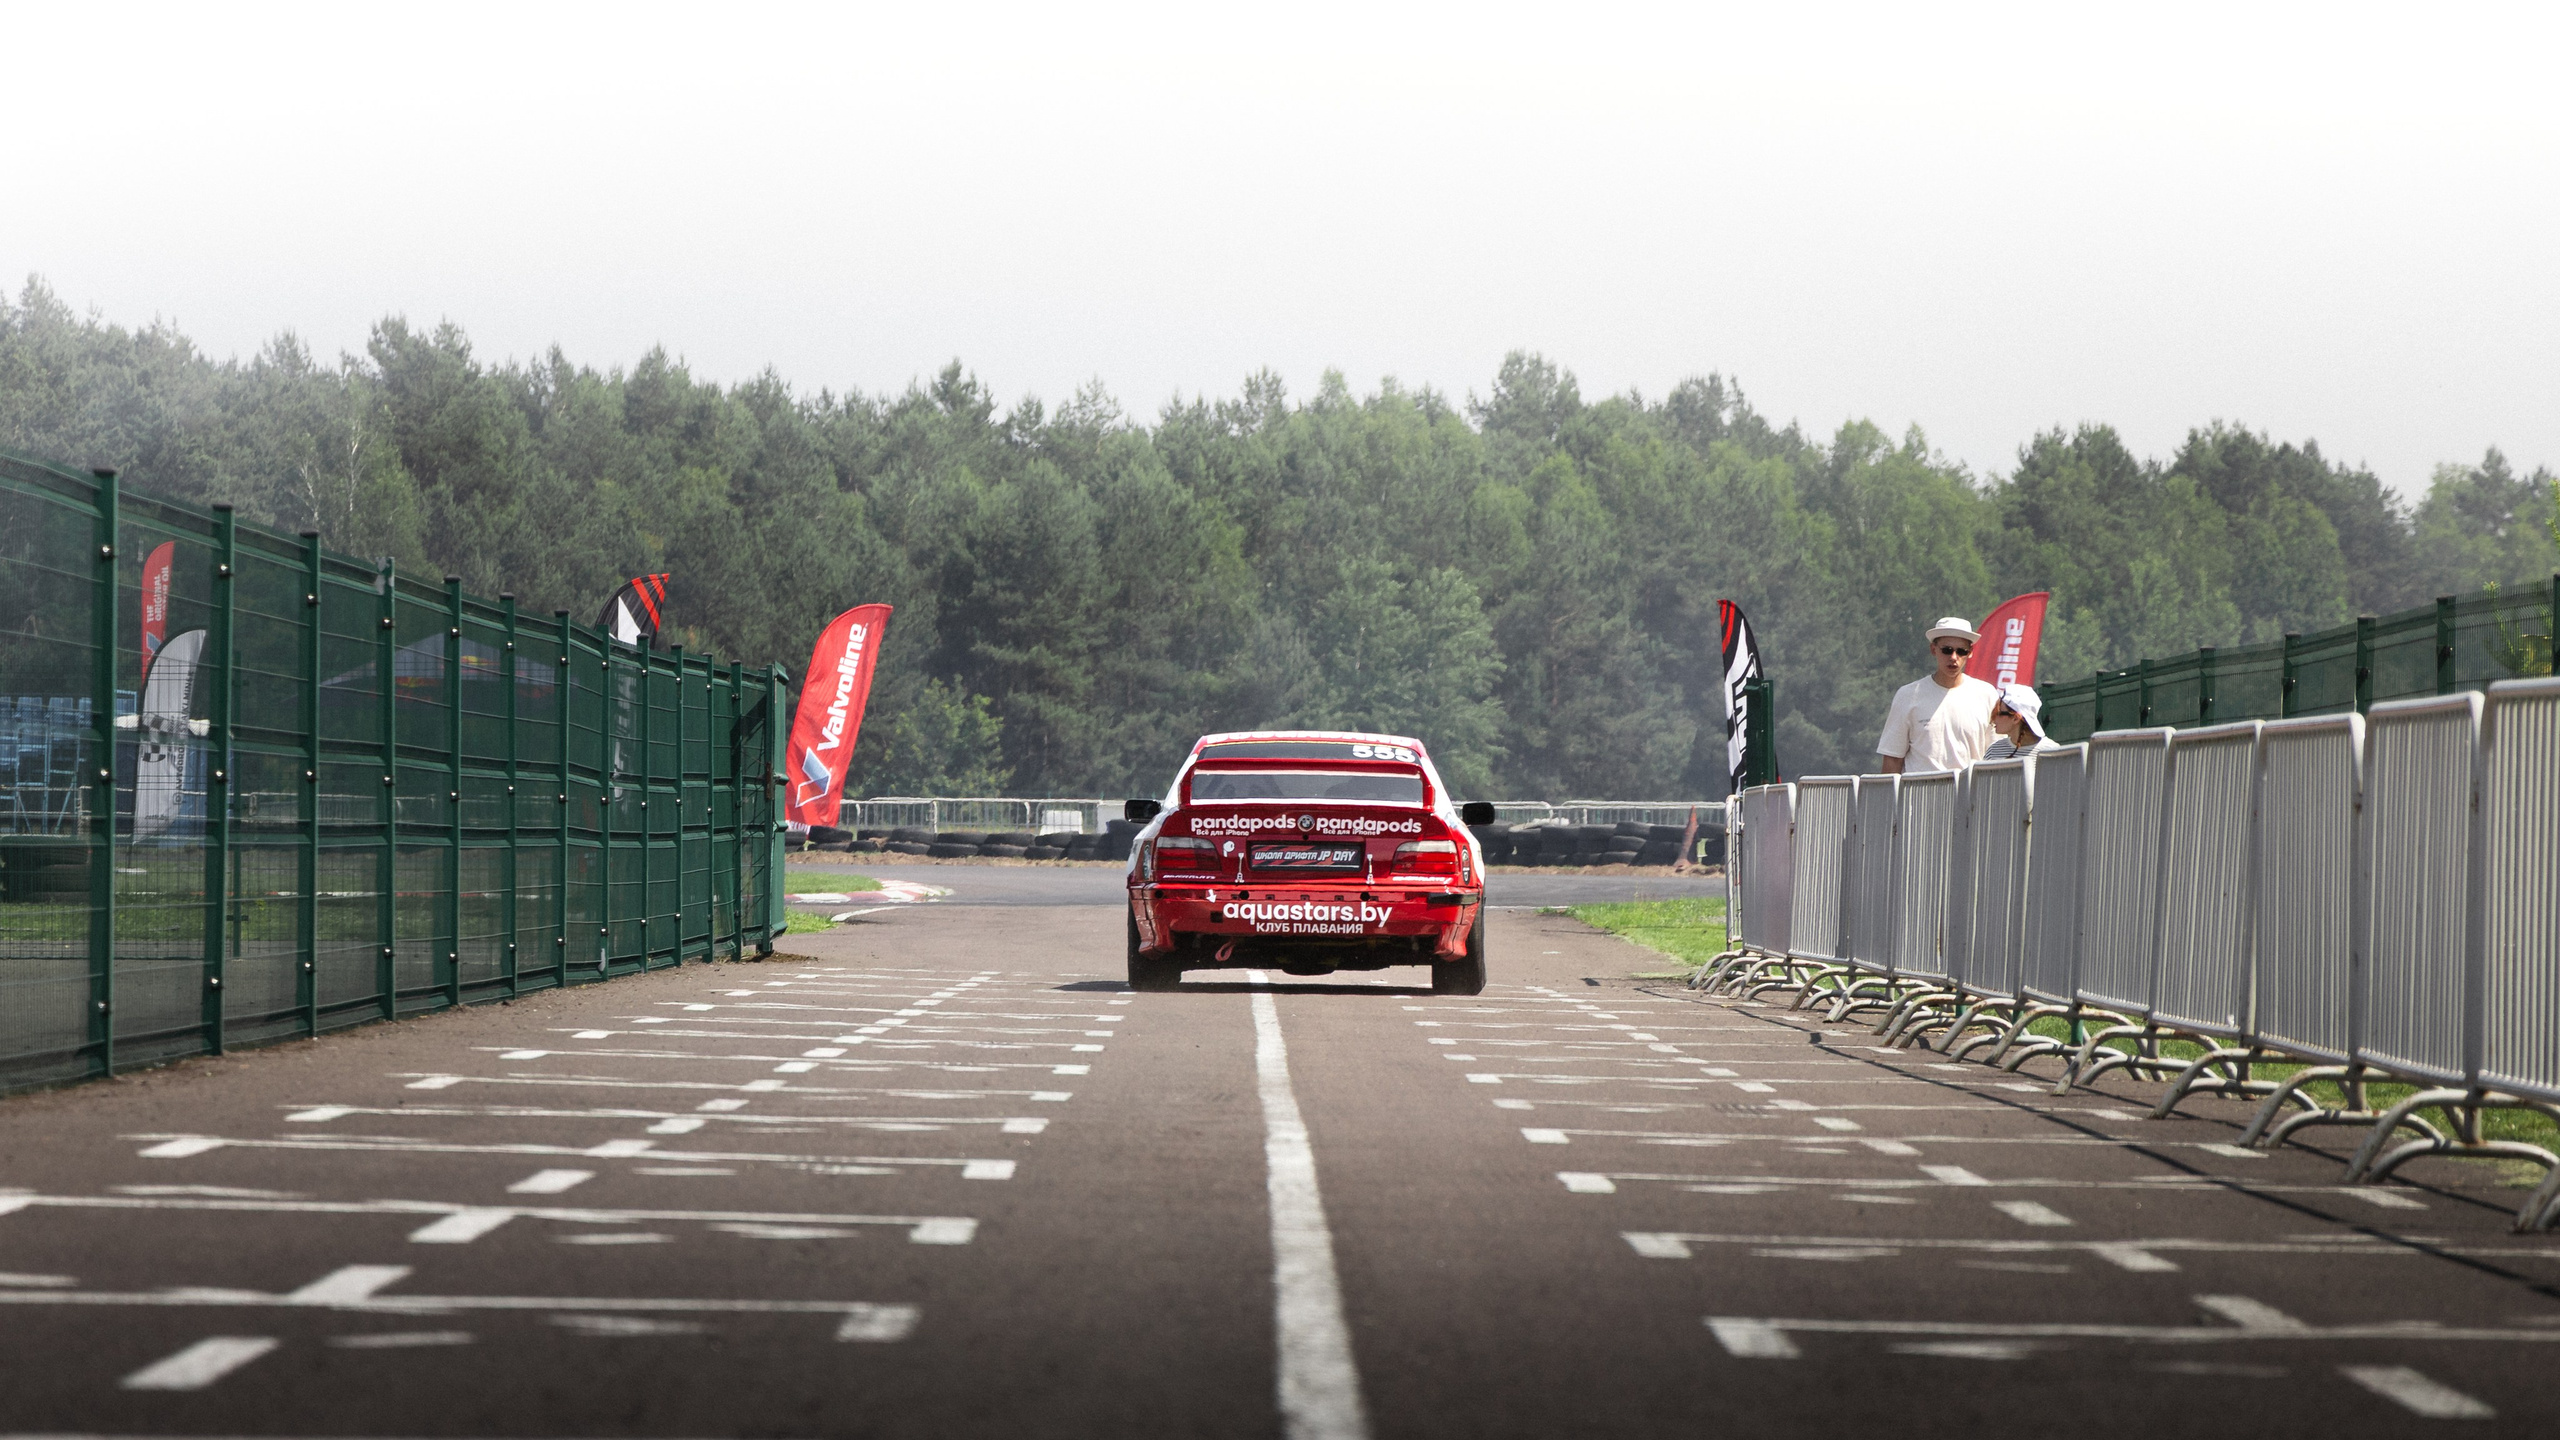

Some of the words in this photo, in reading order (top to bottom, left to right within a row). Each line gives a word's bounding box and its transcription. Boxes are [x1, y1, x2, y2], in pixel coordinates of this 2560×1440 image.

[154, 574, 162, 621] ORIGINAL
[817, 623, 866, 750] Valvoline
[1352, 745, 1415, 763] 555
[1191, 814, 1296, 833] pandapods
[1316, 816, 1422, 835] pandapods
[1254, 851, 1282, 860] ШКОЛА
[1284, 851, 1317, 860] ДРИФТА
[1317, 850, 1331, 861] JP
[1332, 850, 1355, 862] DAY
[1222, 901, 1393, 928] aquastars.by
[1256, 922, 1290, 932] КЛУБ
[1293, 923, 1363, 934] ПЛАВАНИЯ
